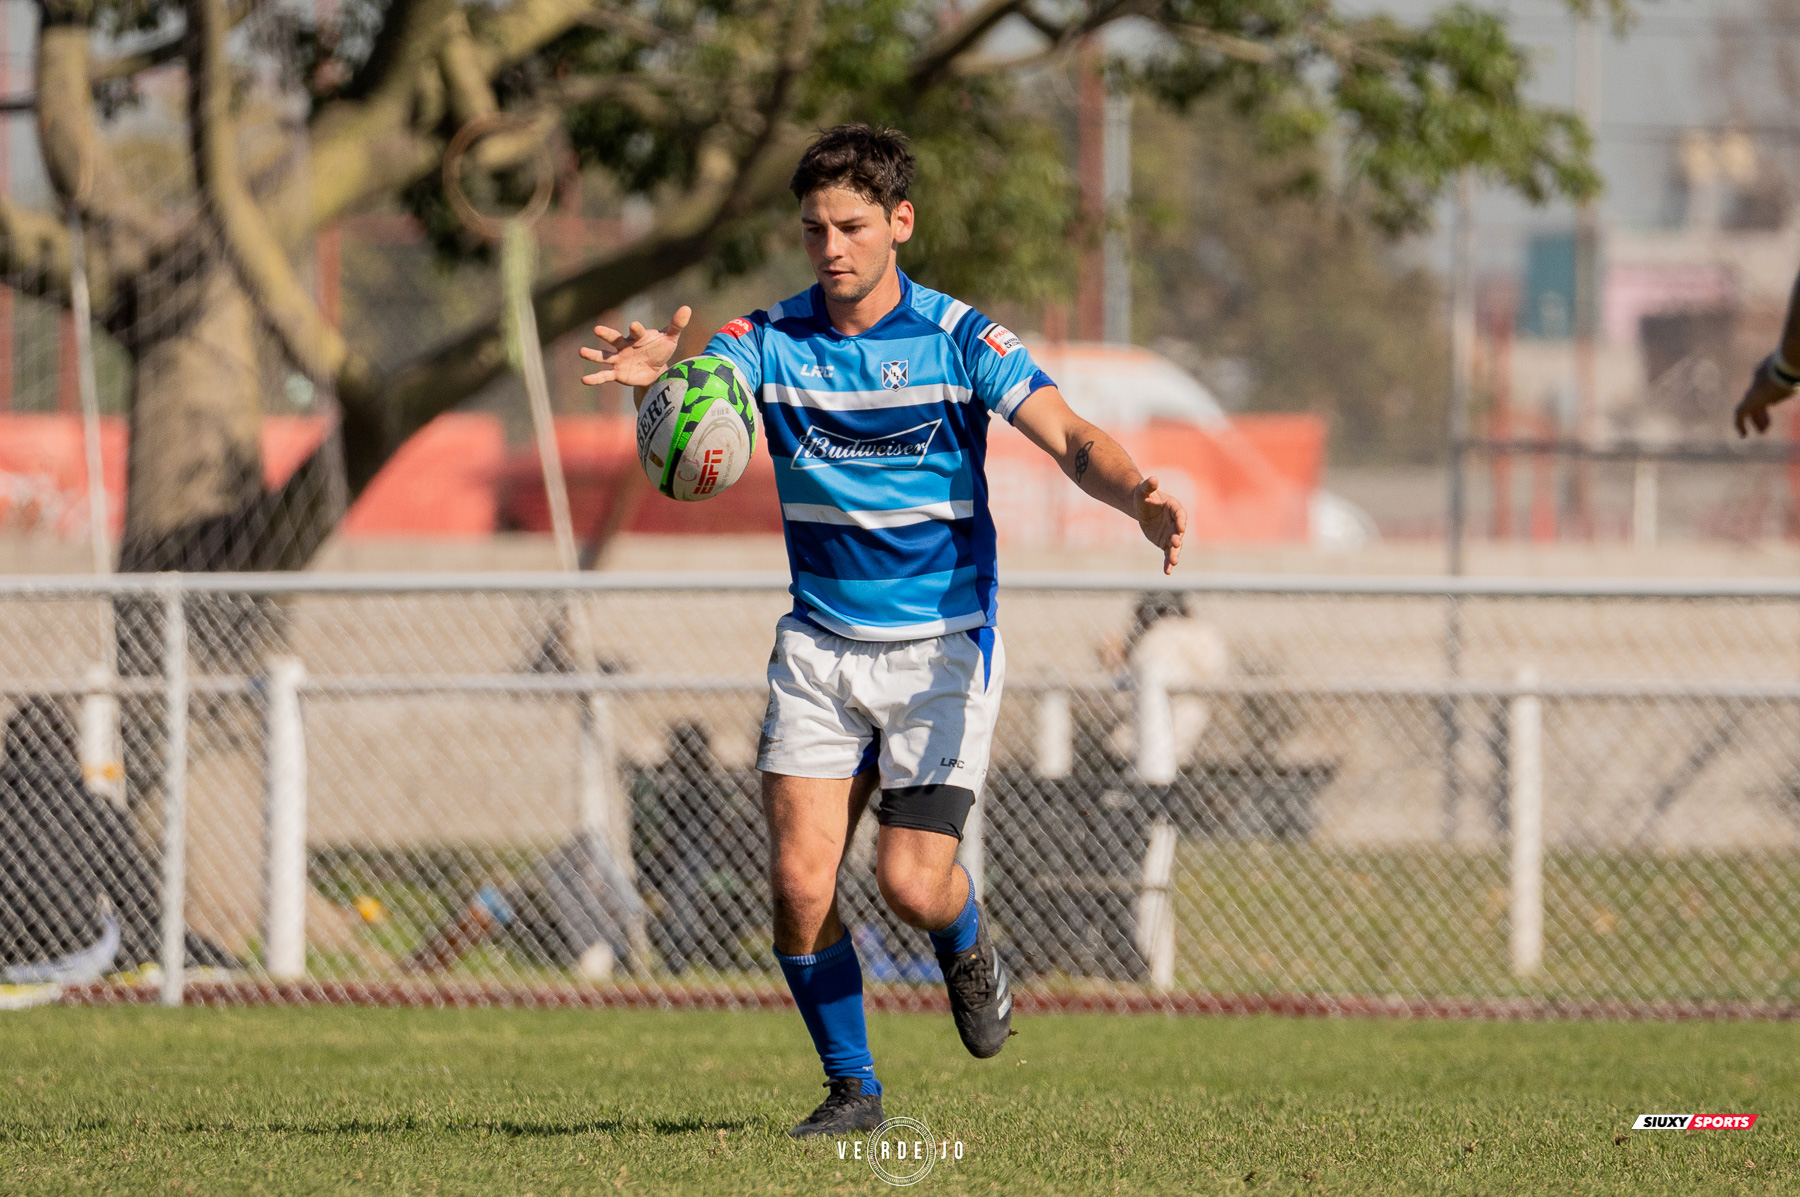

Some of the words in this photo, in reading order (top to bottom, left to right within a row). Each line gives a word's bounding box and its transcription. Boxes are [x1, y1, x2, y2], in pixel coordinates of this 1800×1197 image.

[800, 363, 835, 379] LRC
[799, 434, 929, 460] Budweiser
[693, 449, 724, 495] ESPN
[940, 757, 965, 770] LRC
